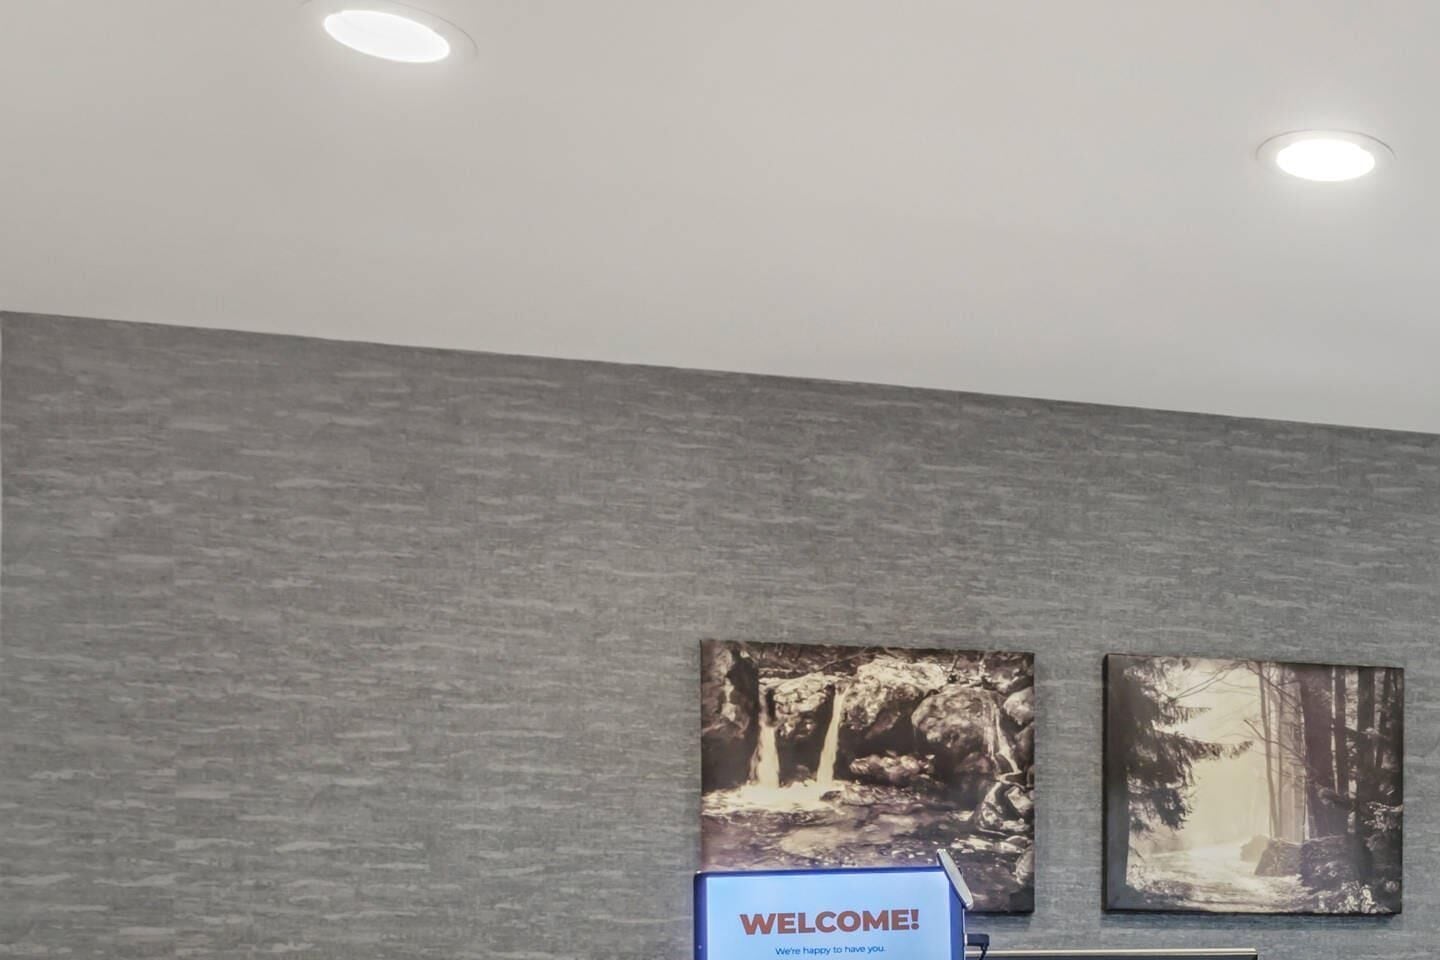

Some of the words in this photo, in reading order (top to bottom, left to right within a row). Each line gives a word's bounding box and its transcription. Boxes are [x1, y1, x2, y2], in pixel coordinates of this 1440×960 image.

[739, 909, 919, 935] WELCOME!
[775, 947, 801, 955] We're
[803, 947, 831, 956] happy
[833, 946, 843, 954] to
[844, 945, 866, 953] have
[867, 945, 886, 954] you.
